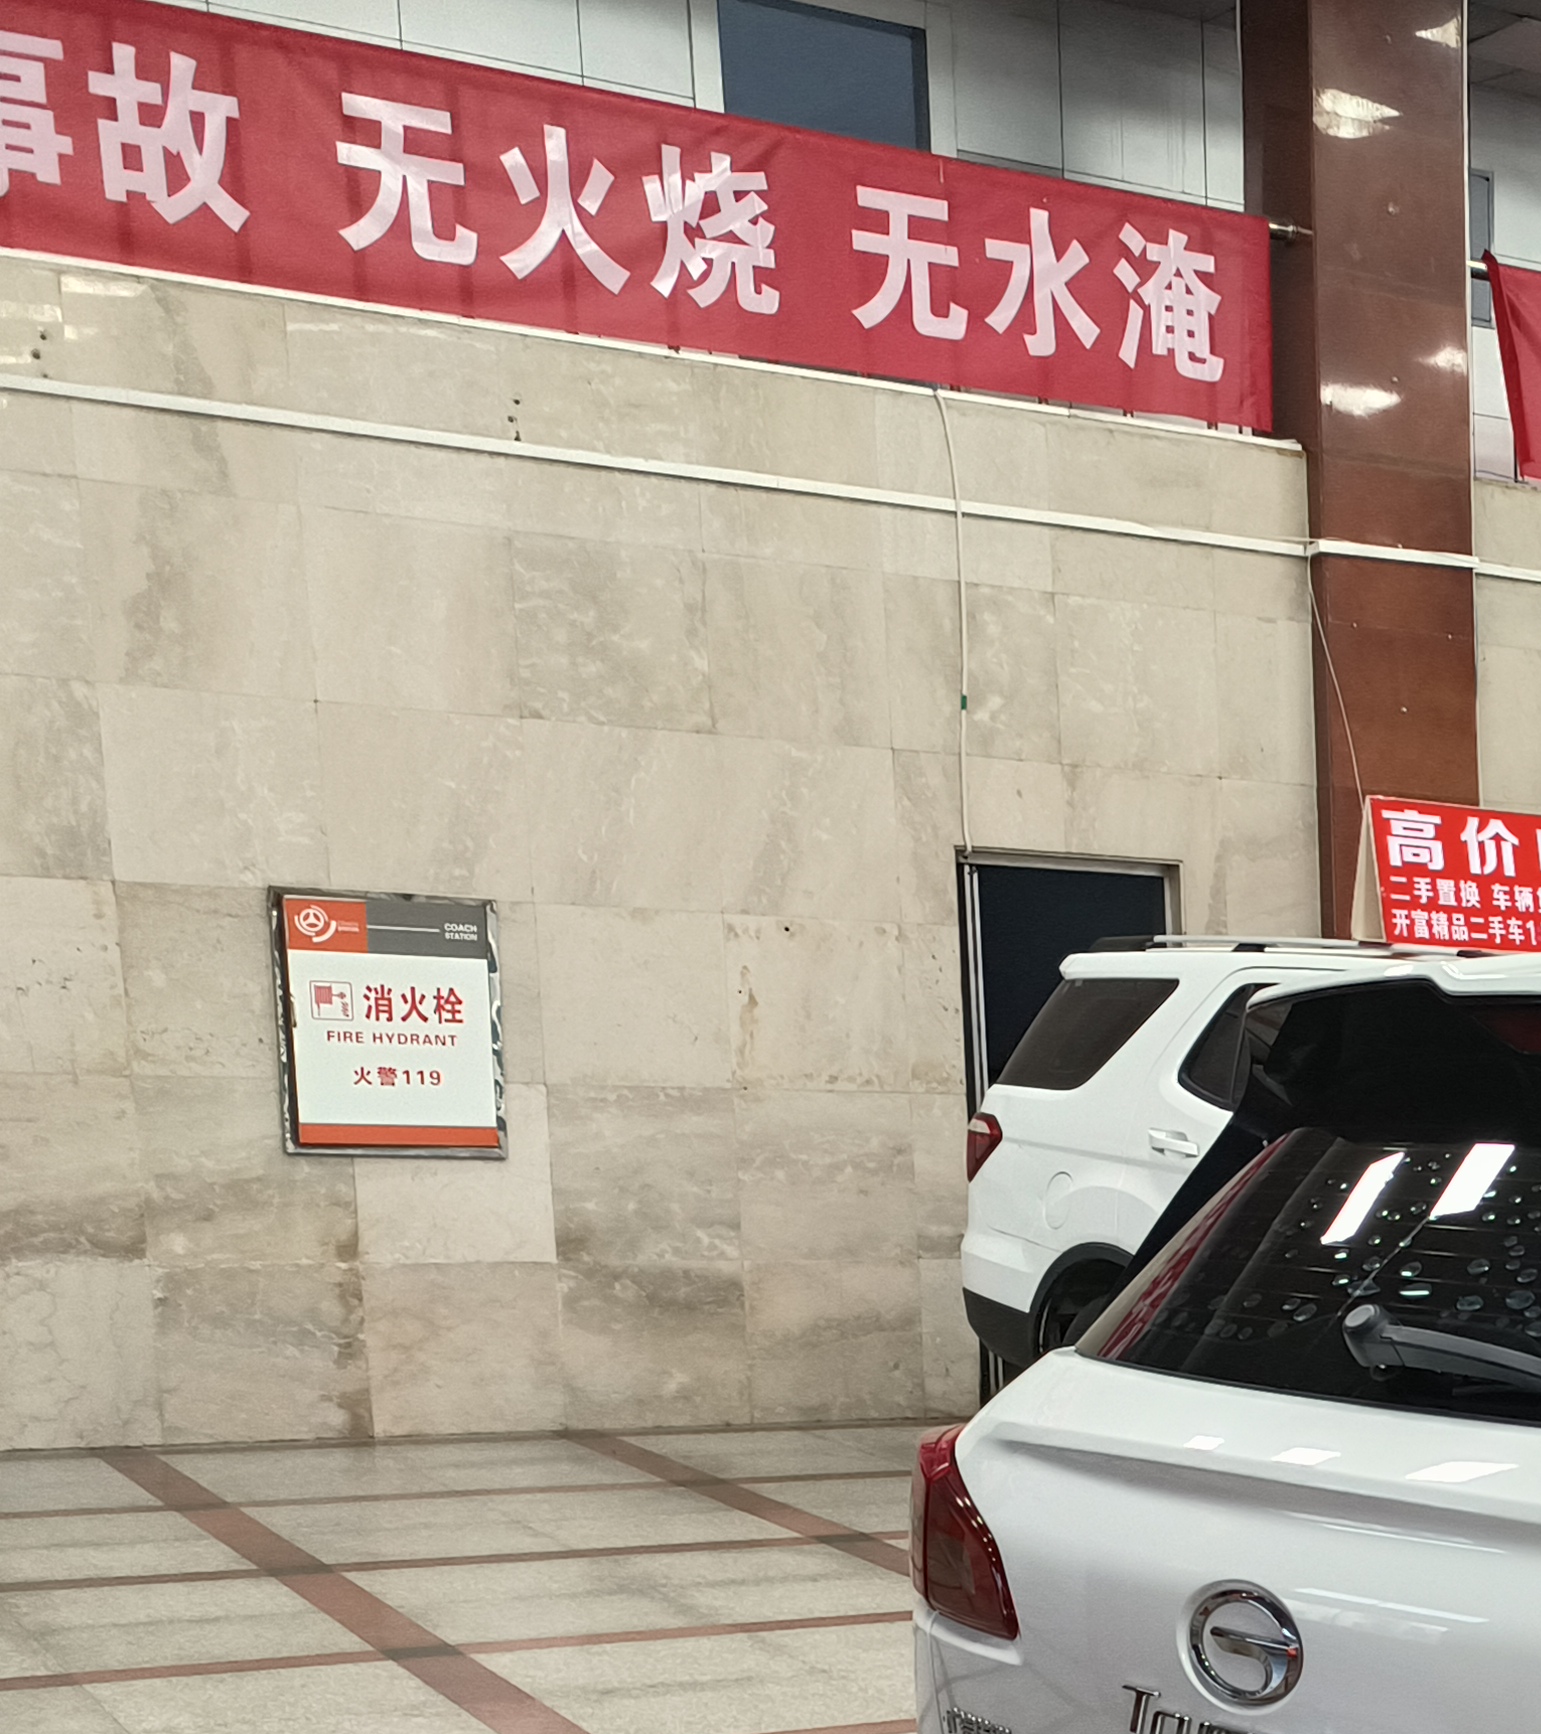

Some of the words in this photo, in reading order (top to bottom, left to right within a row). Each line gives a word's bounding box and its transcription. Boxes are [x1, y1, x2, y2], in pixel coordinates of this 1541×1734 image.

[335, 91, 783, 316] 无火烧
[850, 184, 1226, 384] 无水淹
[1389, 875, 1481, 909] 二手置换
[444, 922, 478, 932] COACH
[363, 984, 465, 1025] 消火栓
[326, 1030, 364, 1045] FIRE
[372, 1032, 458, 1047] HYDRANT
[353, 1066, 442, 1087] 火警119
